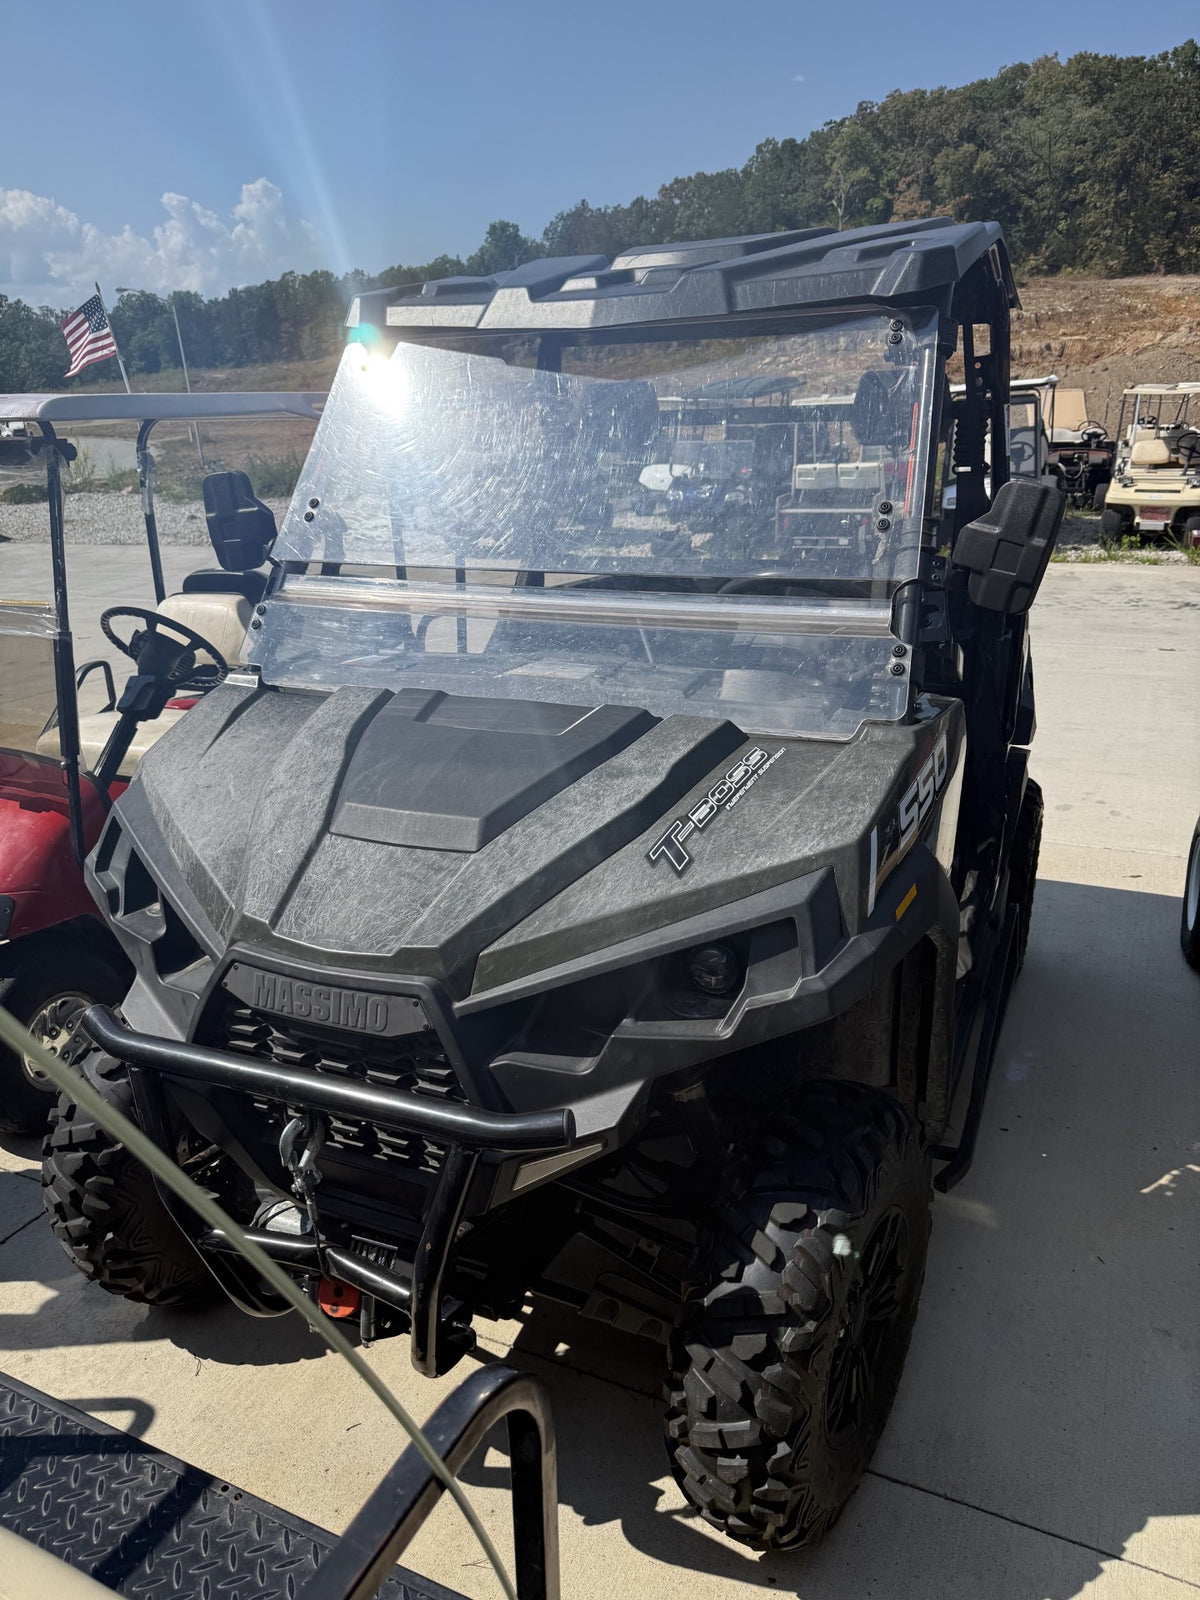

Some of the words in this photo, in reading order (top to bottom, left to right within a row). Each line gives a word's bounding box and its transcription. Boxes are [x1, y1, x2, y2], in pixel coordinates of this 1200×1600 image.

[649, 746, 768, 871] T-BOSS
[900, 735, 948, 850] 550
[252, 972, 389, 1033] MASSIMO
